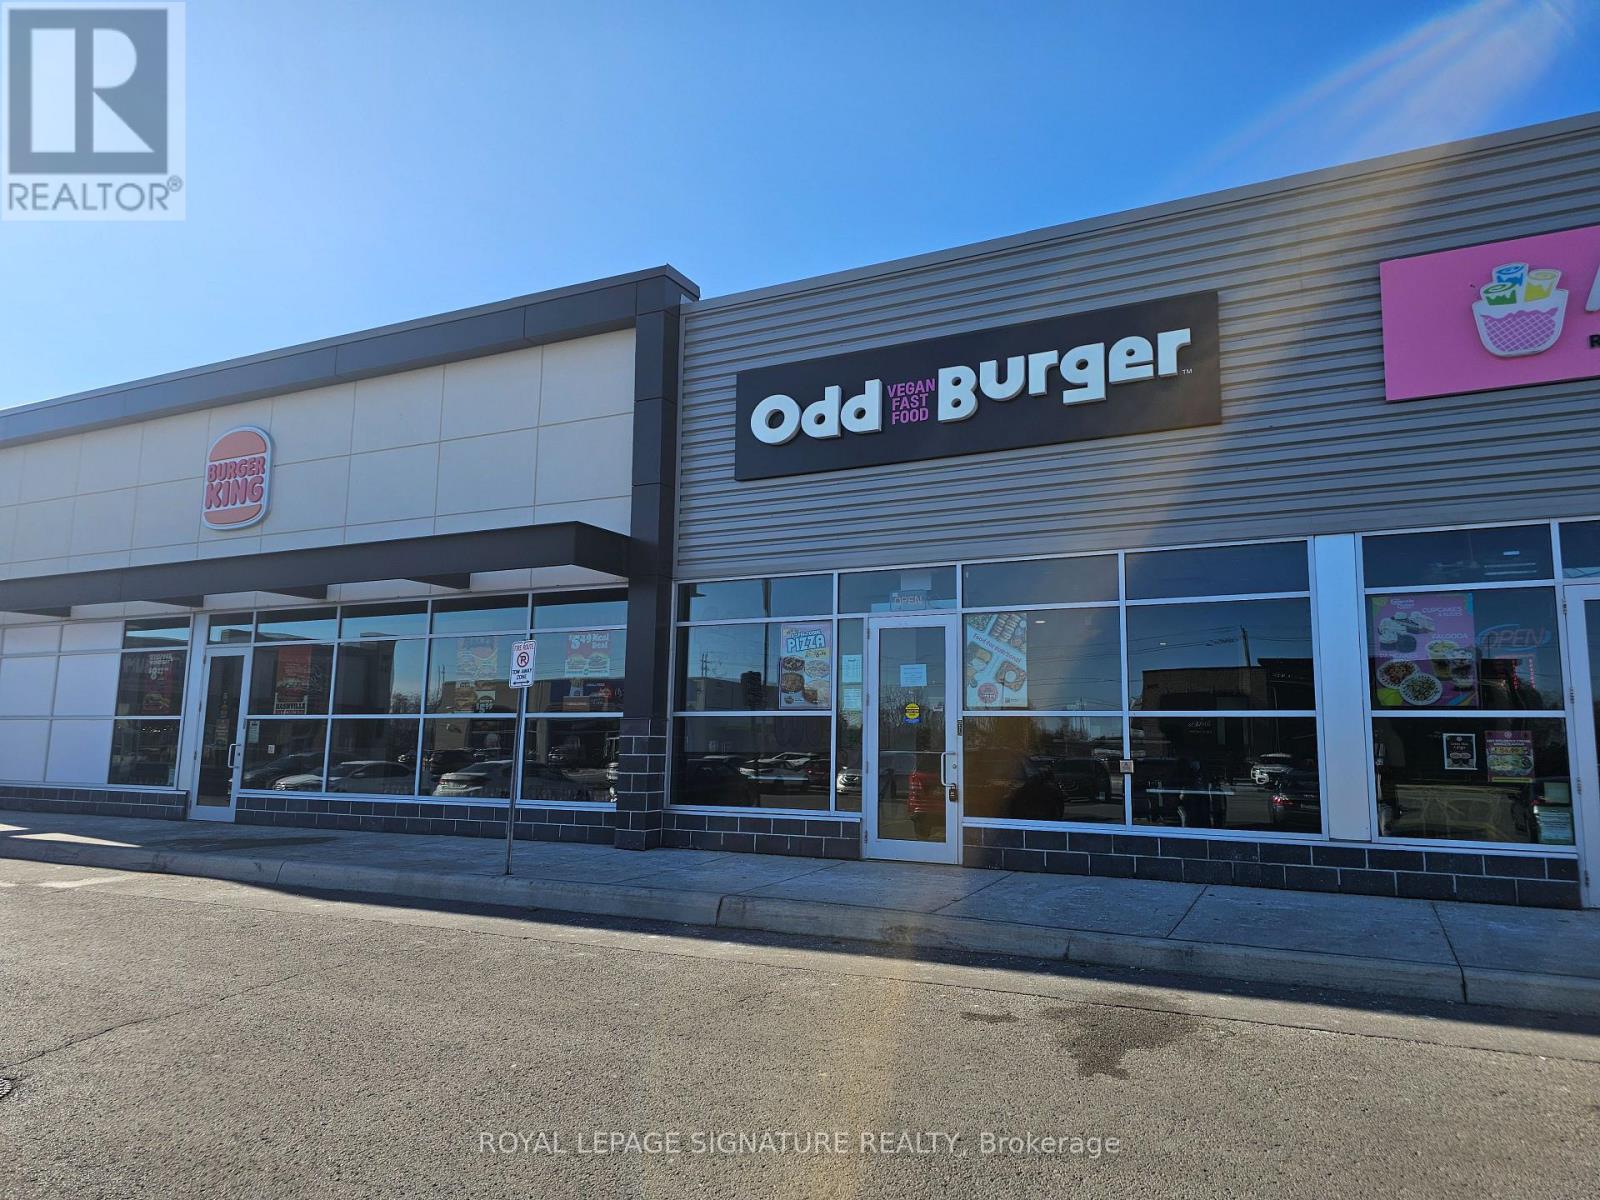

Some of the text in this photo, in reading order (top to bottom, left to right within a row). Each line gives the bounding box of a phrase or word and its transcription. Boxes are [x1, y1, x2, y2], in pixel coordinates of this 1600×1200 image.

[751, 327, 1192, 446] Odd Burger
[887, 377, 936, 400] VEGAN
[890, 393, 929, 411] FAST
[890, 407, 930, 425] FOOD
[207, 456, 266, 482] BURGER
[204, 476, 265, 509] KING
[786, 633, 826, 654] PIZZA
[1484, 627, 1544, 649] OPEN
